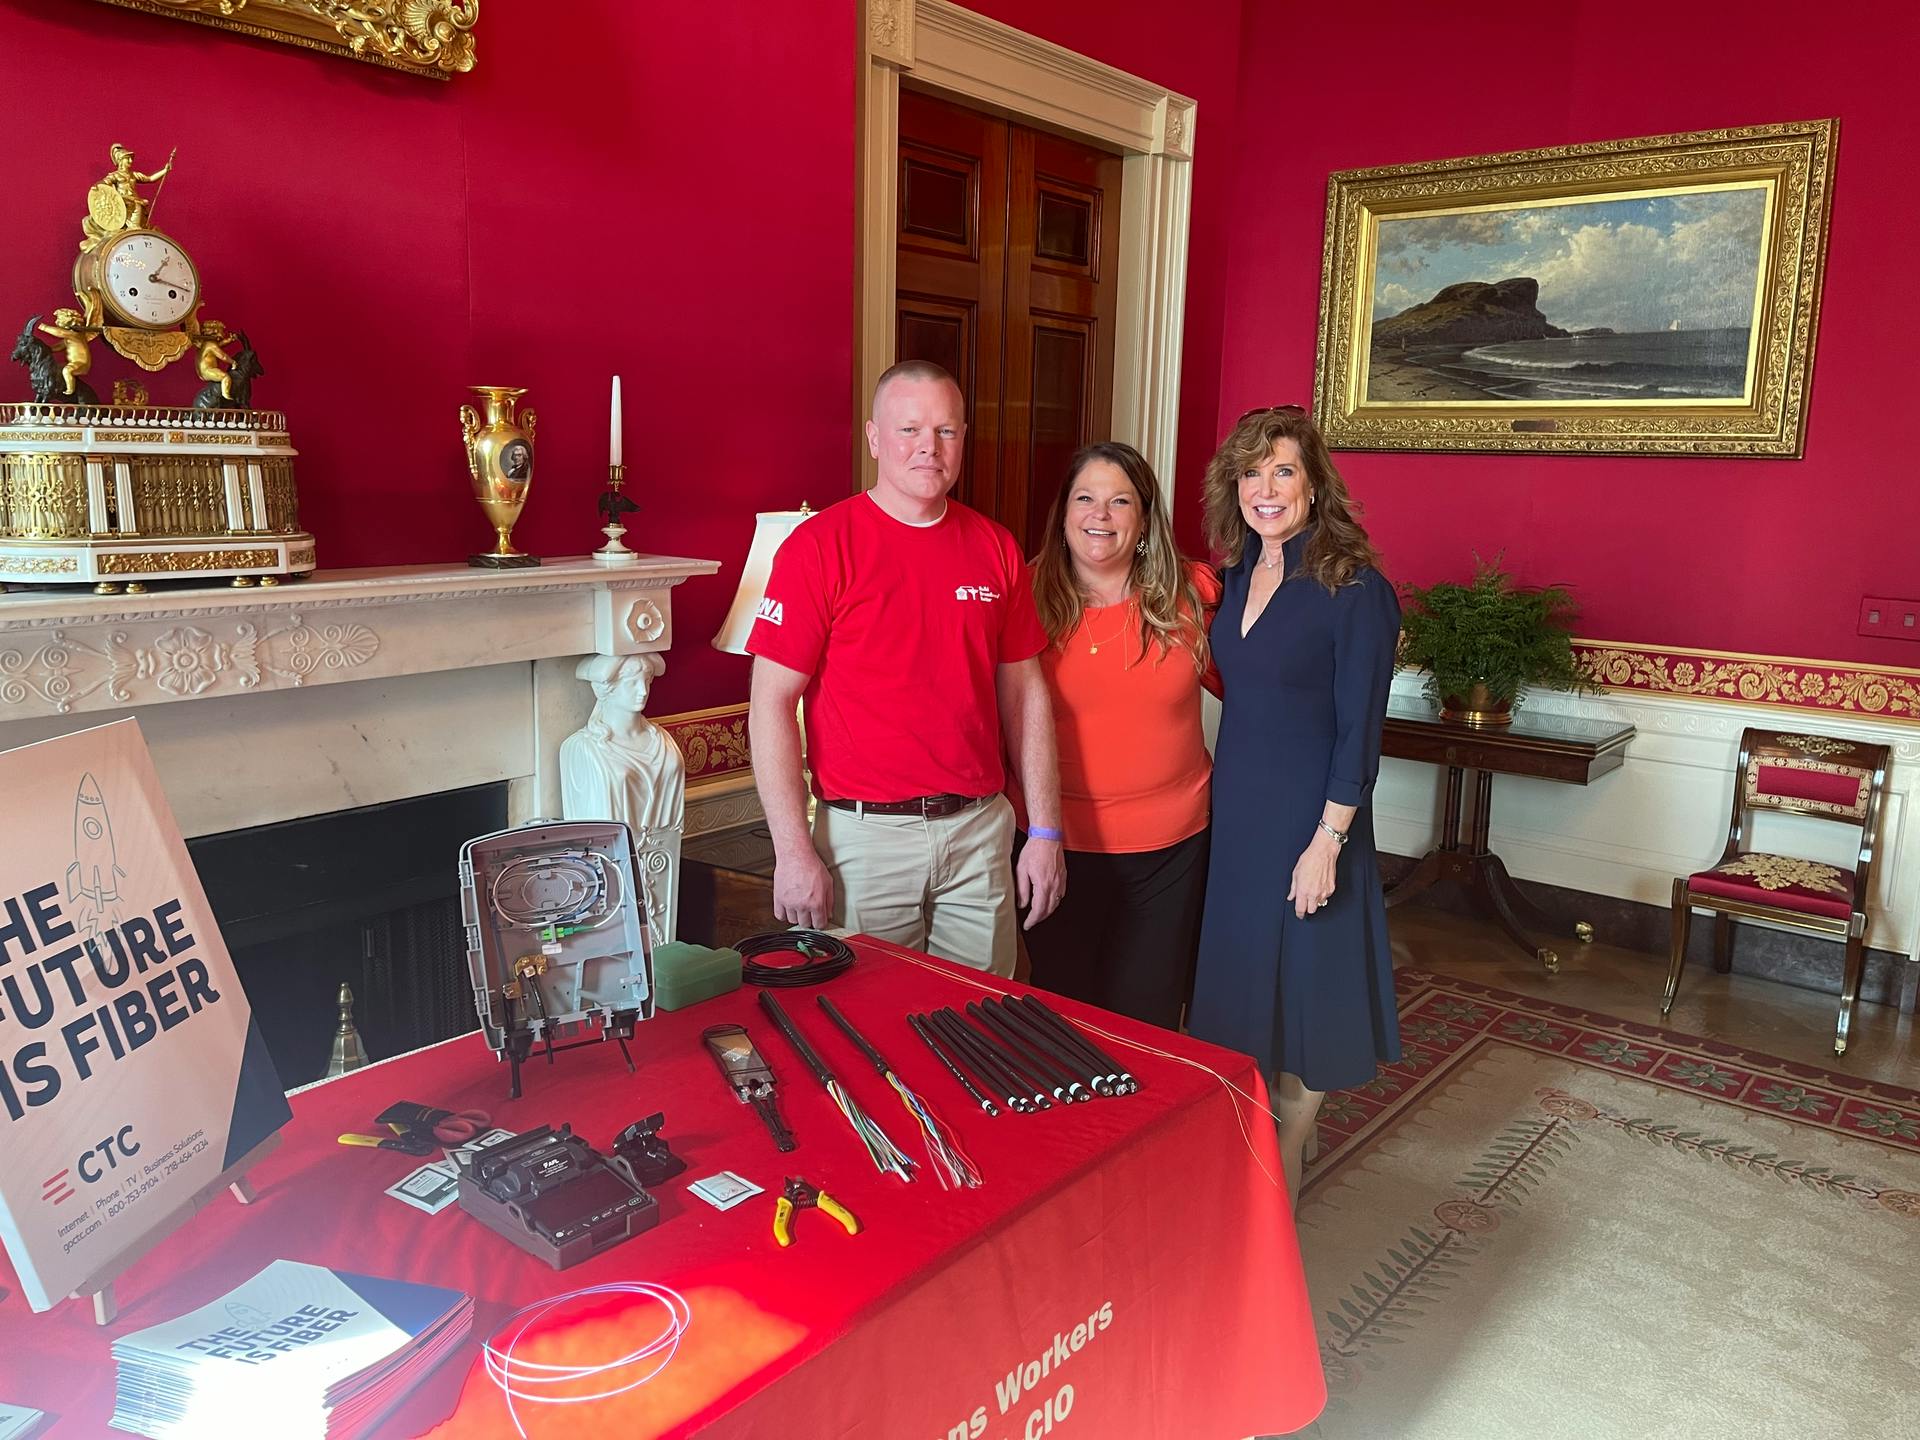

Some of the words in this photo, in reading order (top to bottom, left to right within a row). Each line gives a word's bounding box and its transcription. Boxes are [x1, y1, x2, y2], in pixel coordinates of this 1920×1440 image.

[0, 898, 196, 1029] UTURE
[0, 1041, 62, 1122] IS
[60, 958, 221, 1081] FIBER
[57, 1211, 89, 1237] Internet
[95, 1189, 120, 1209] Phone
[126, 1174, 137, 1187] TV
[143, 1150, 174, 1175] Business
[173, 1129, 204, 1154] Solutions
[77, 1124, 141, 1184] CTC
[63, 1219, 102, 1255] goctc.com
[108, 1176, 159, 1217] 800-753-9104
[176, 1326, 250, 1351] THE
[205, 1304, 331, 1359] FUTURE
[235, 1350, 277, 1365] IS
[267, 1309, 359, 1352] FIBER
[937, 1405, 988, 1440] ns
[995, 1300, 1113, 1415] Workers
[1003, 1384, 1075, 1440] CIO
